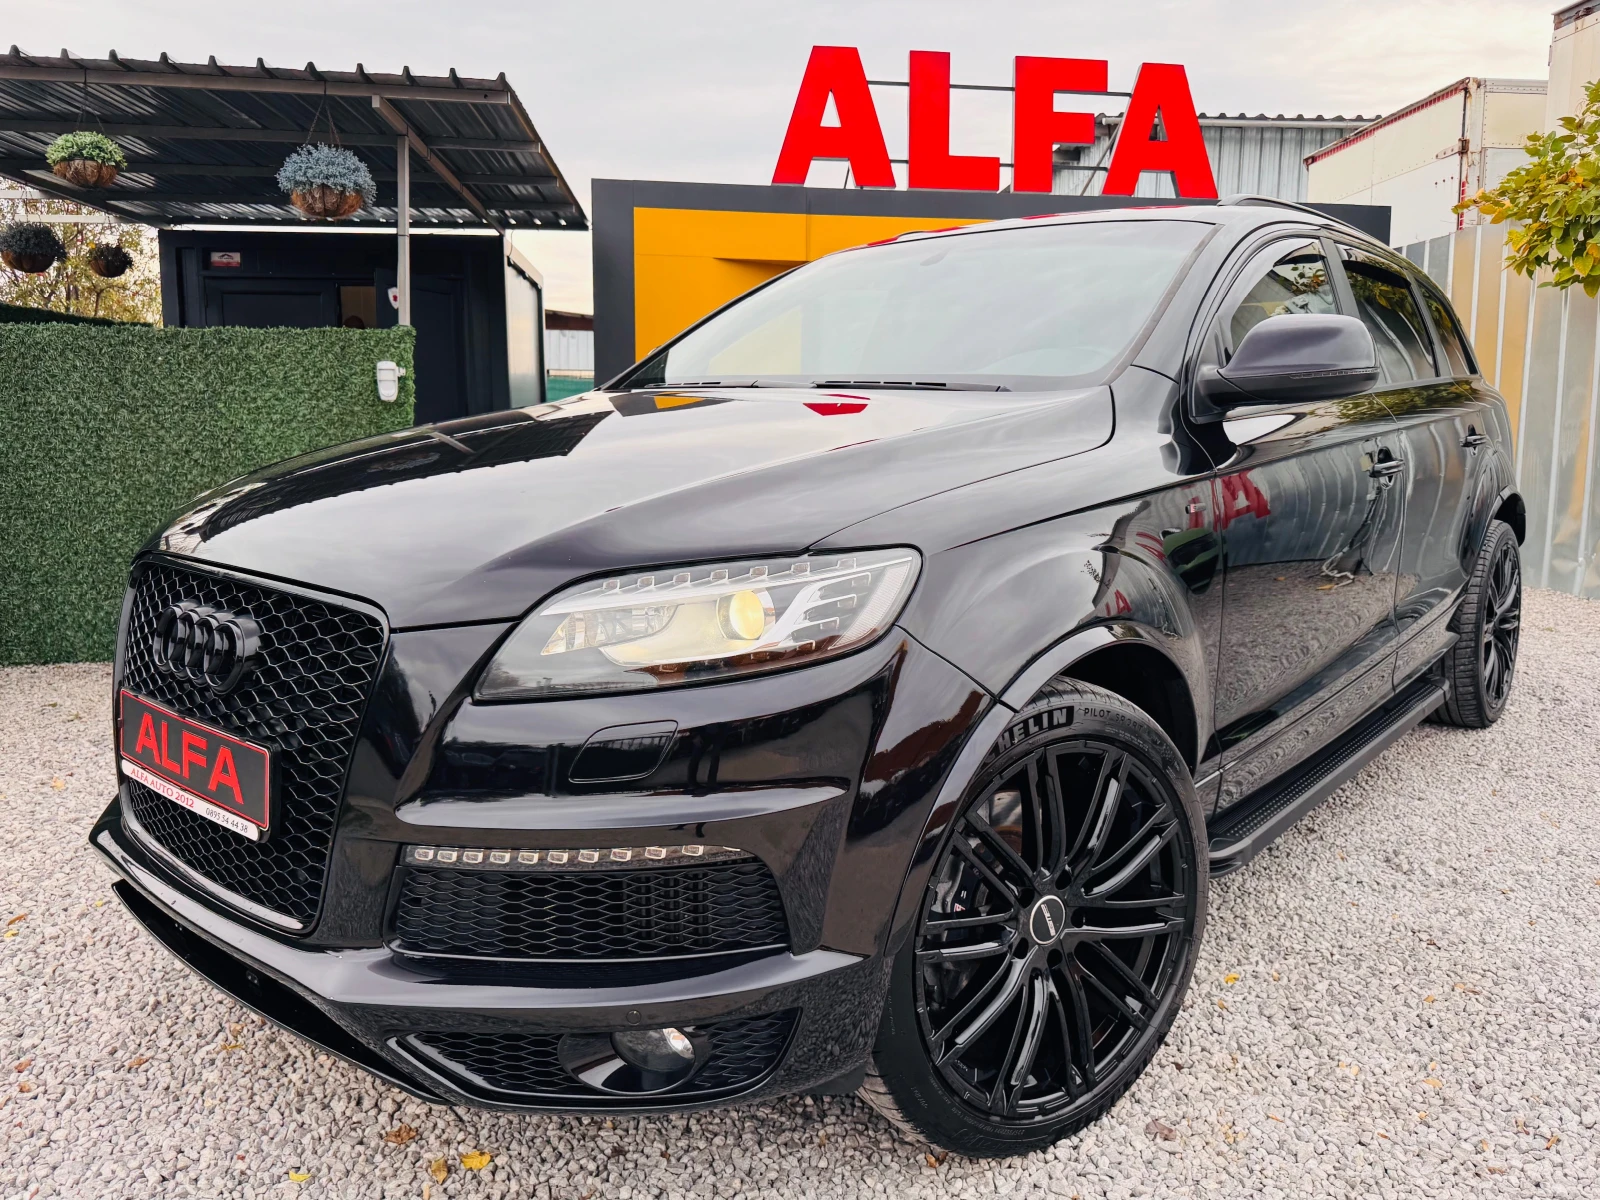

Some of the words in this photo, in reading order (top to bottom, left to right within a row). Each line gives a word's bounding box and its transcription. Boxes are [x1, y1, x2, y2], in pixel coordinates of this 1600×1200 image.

[771, 45, 1219, 199] ALFA
[1083, 707, 1111, 718] PILOT
[1115, 713, 1144, 730] SPORT
[131, 767, 148, 784] ALFA
[149, 779, 174, 797] AUTO
[175, 791, 195, 809] 2012
[135, 712, 244, 805] ALFA
